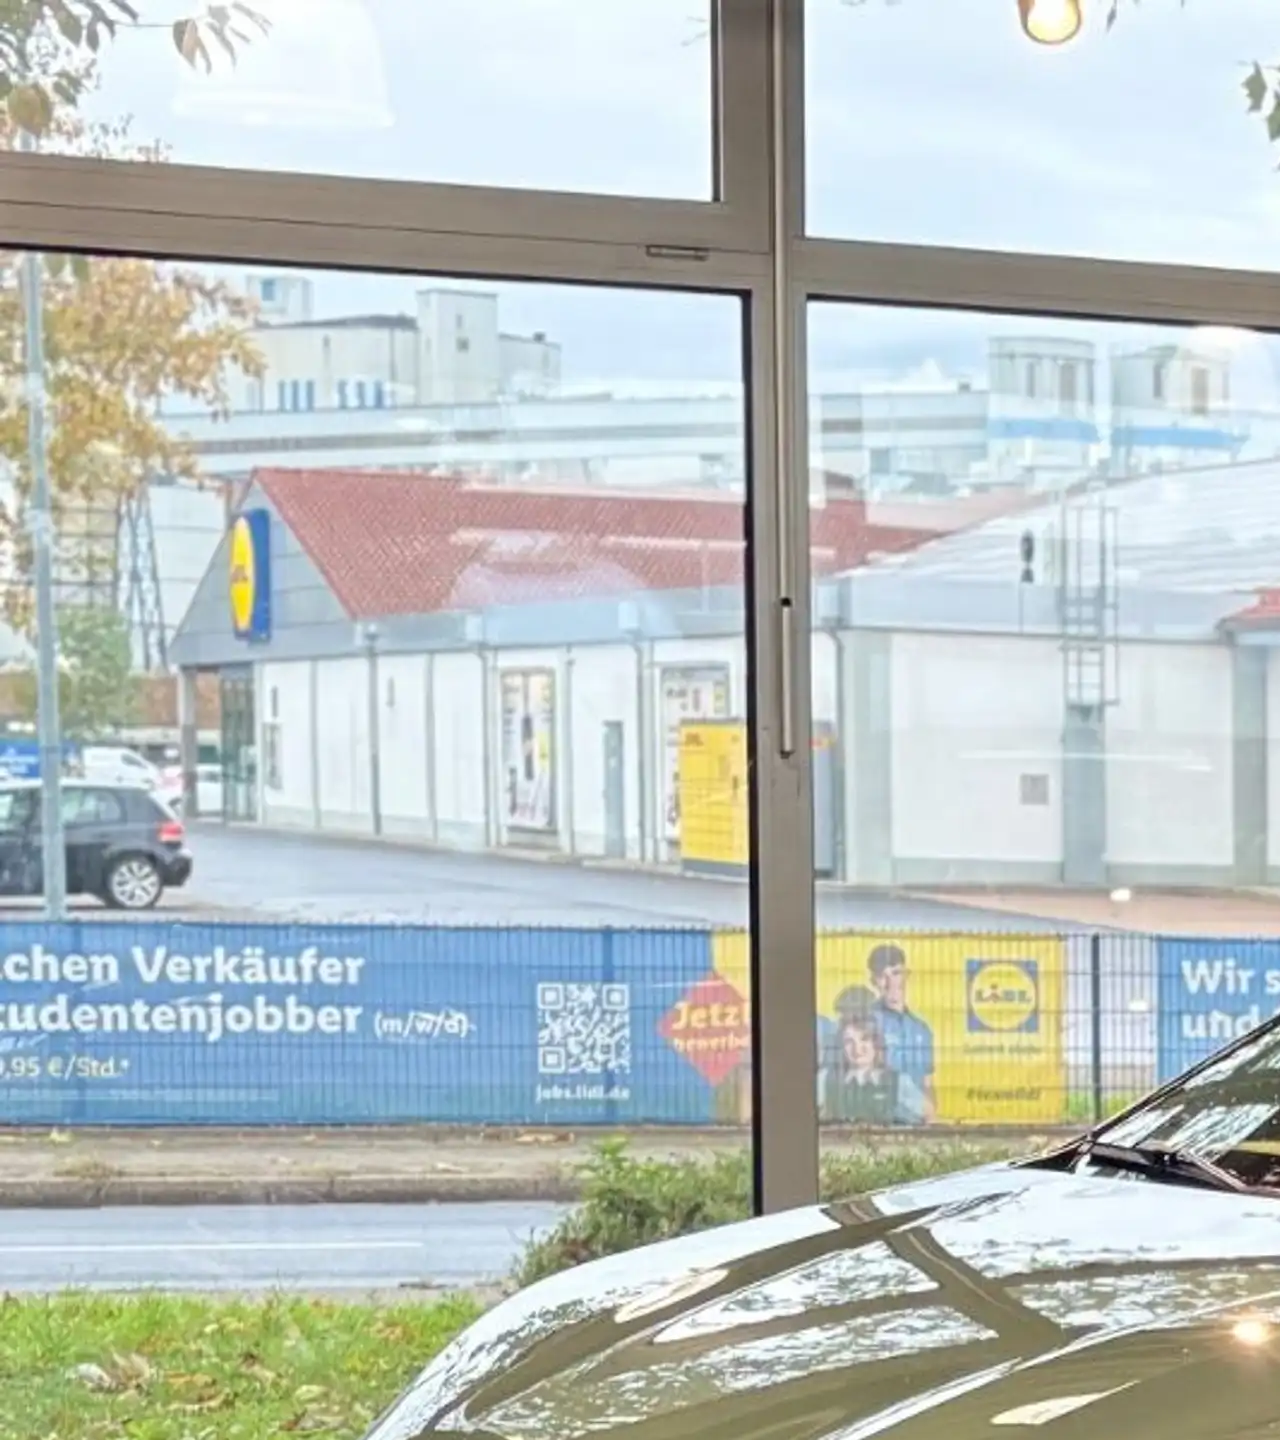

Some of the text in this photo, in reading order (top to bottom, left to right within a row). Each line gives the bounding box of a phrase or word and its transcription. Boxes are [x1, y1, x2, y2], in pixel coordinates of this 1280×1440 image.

[0, 943, 366, 985] chen Verkäufer
[1181, 958, 1256, 995] Wir
